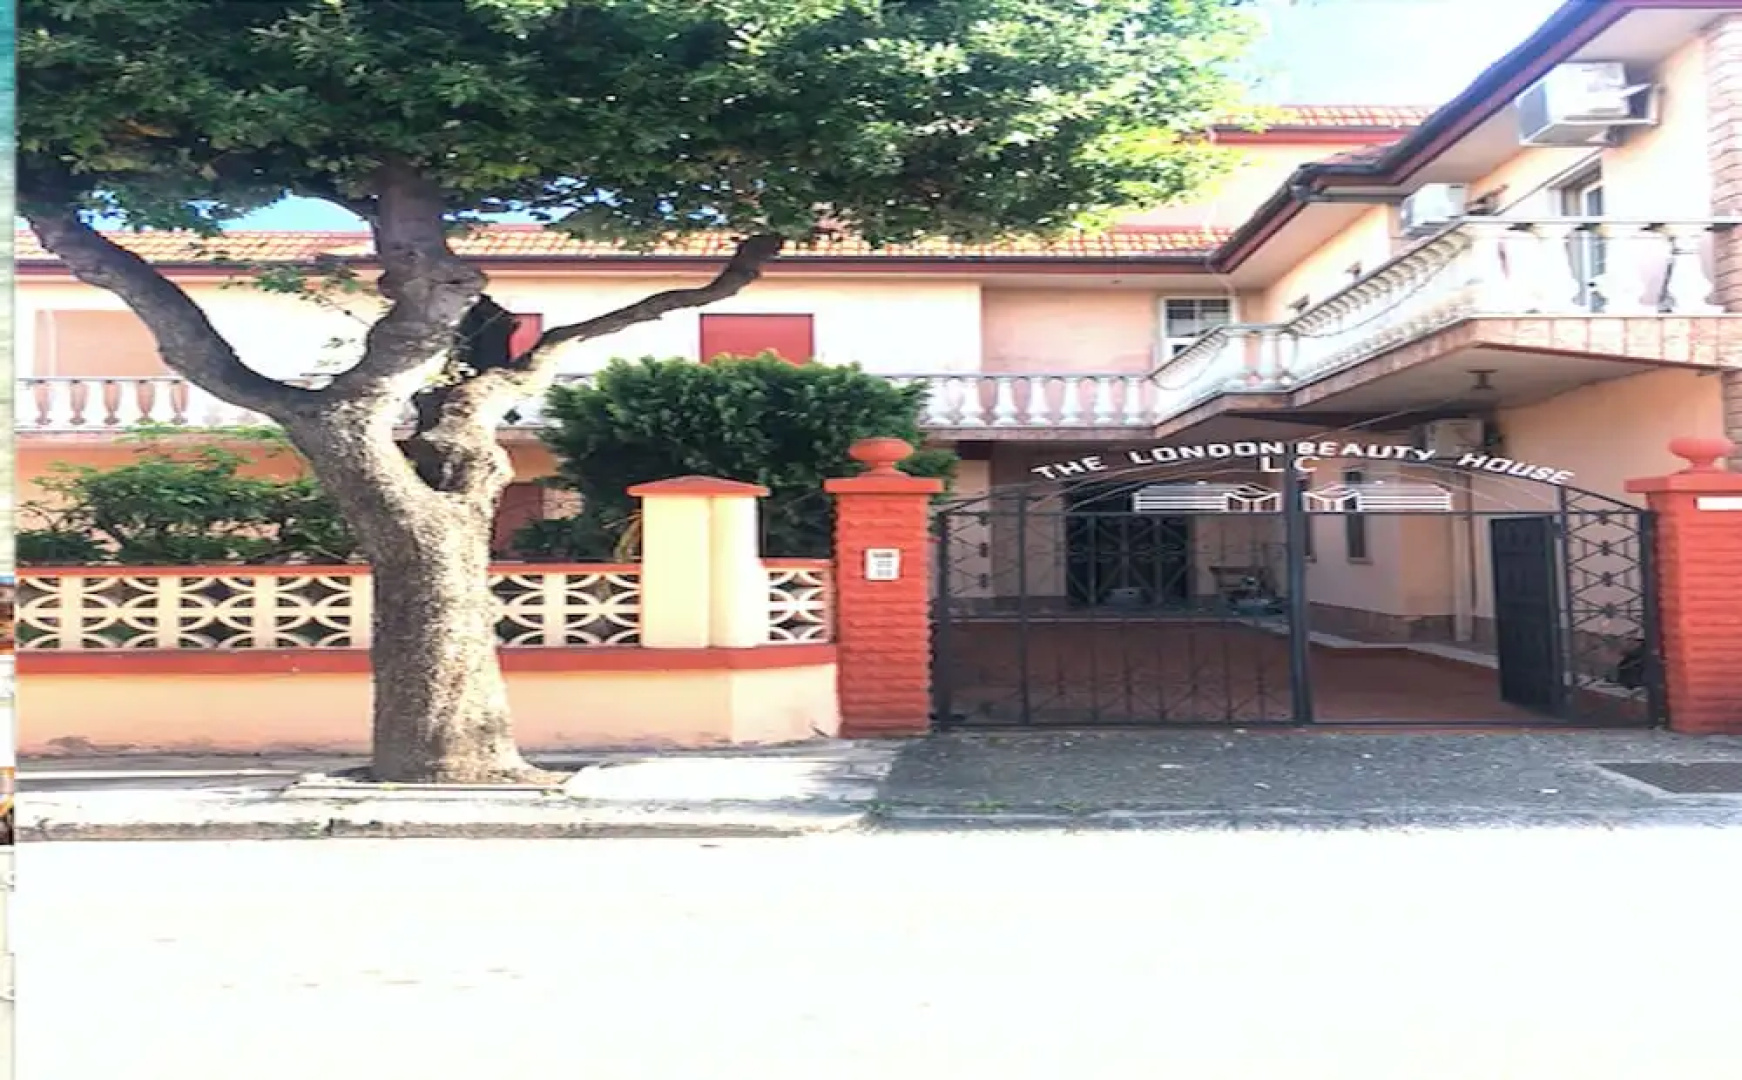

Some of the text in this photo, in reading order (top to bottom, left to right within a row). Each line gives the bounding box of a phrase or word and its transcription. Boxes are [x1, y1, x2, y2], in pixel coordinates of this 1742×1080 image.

[1031, 441, 1576, 486] THE LONDON BEAUTY HOUSE
